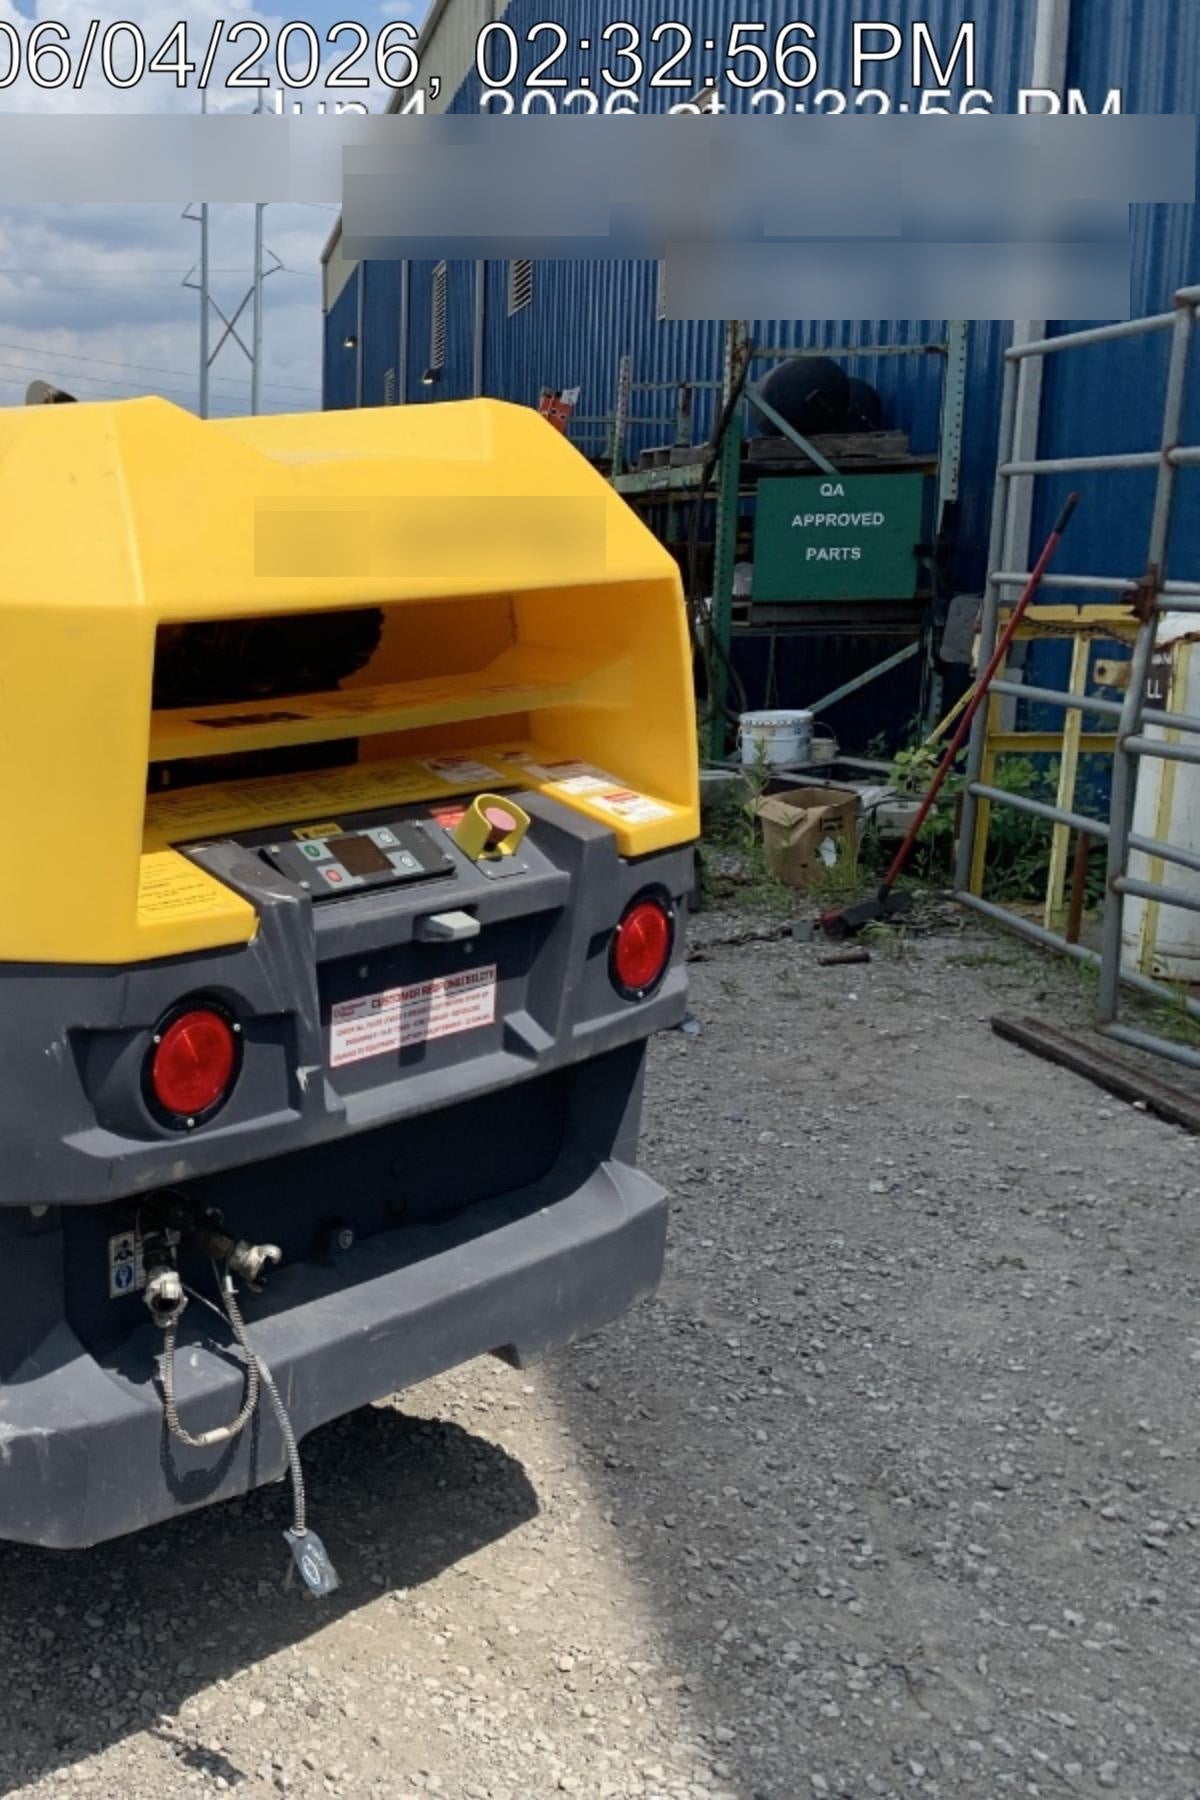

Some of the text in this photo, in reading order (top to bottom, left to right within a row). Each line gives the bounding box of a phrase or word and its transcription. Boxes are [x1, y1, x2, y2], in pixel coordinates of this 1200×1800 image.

[819, 483, 845, 498] QA
[791, 512, 885, 527] APPROVED
[805, 547, 862, 561] PARTS
